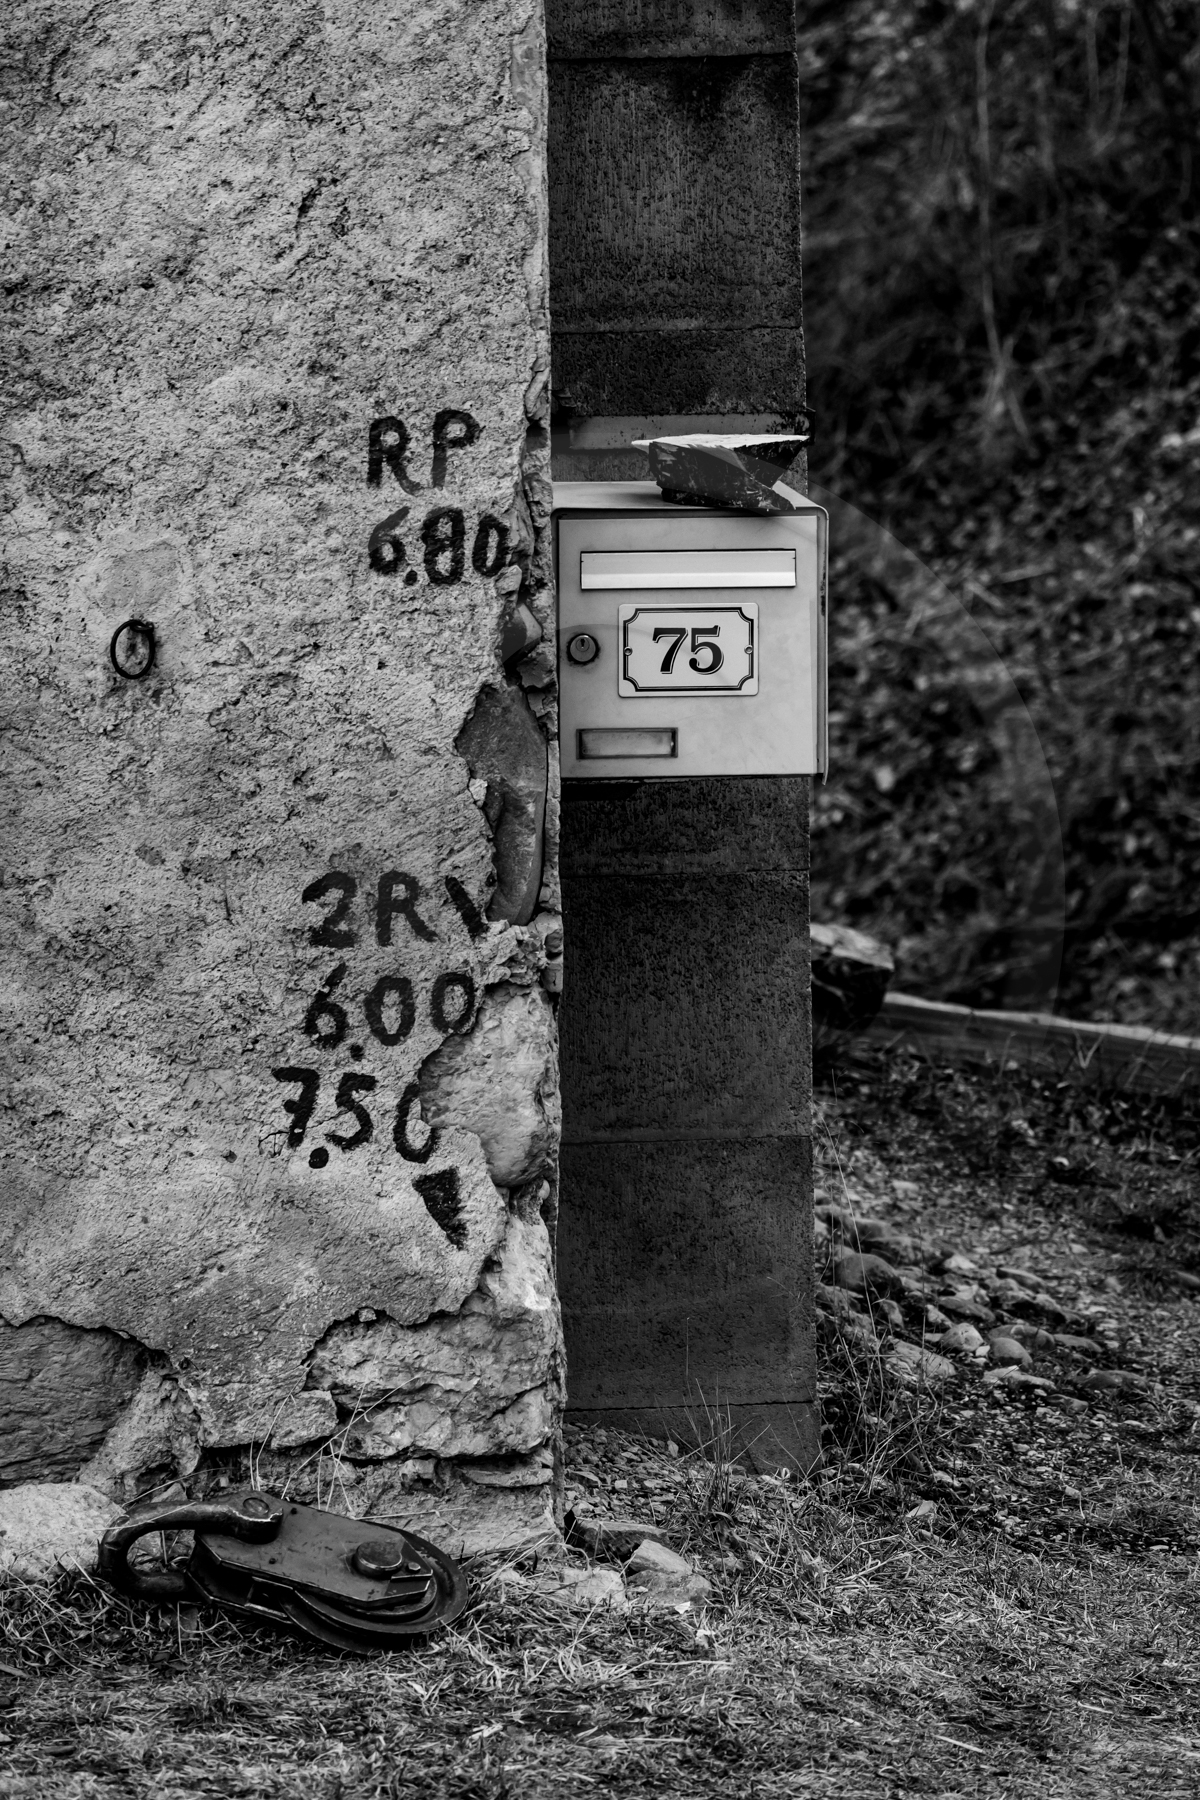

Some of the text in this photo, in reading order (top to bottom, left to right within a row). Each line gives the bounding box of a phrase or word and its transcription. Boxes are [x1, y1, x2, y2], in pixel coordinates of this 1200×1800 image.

[367, 408, 485, 496] RP
[367, 505, 510, 586] 6.80
[652, 625, 724, 675] 75
